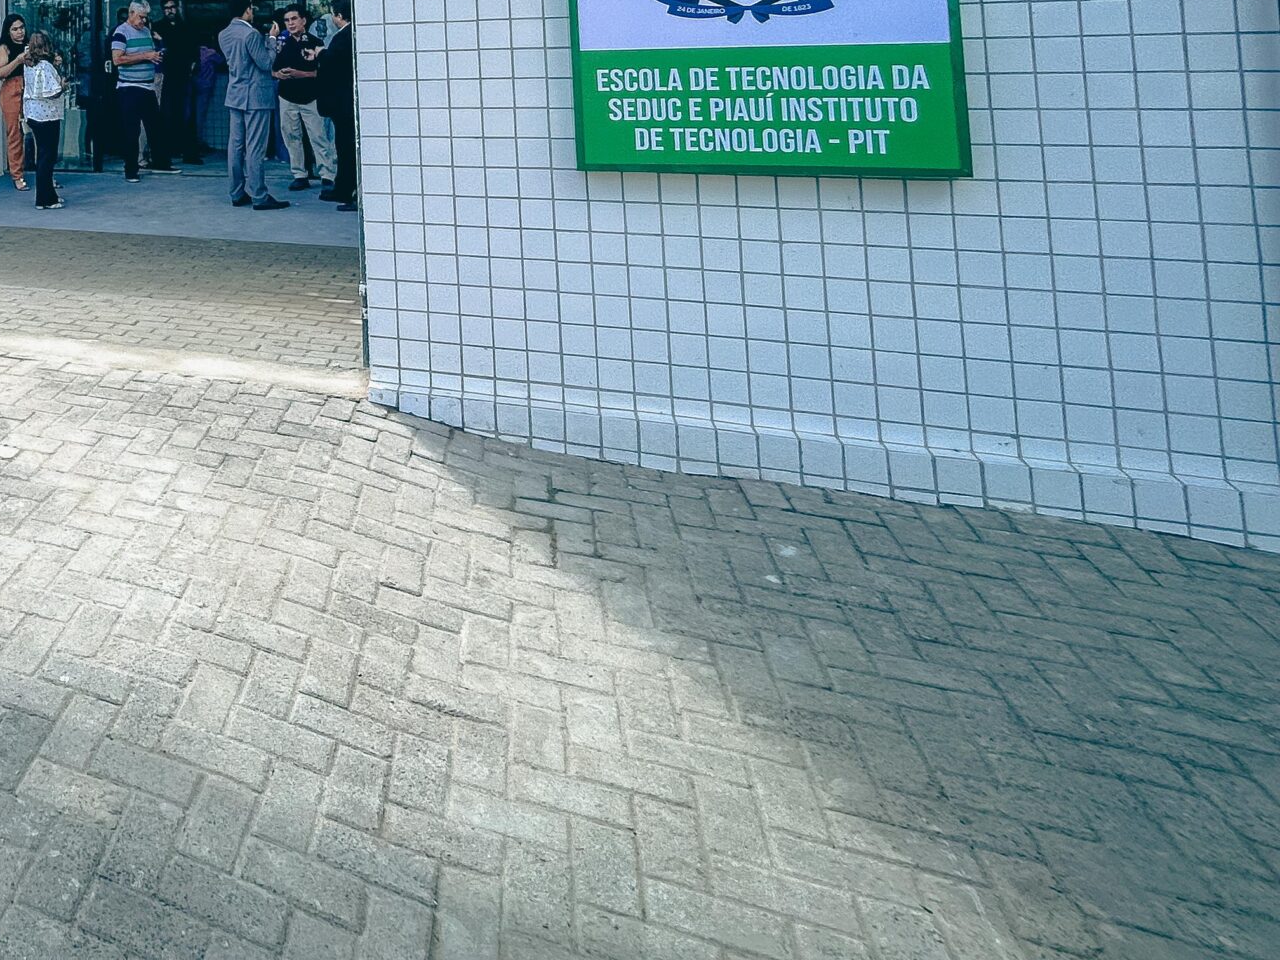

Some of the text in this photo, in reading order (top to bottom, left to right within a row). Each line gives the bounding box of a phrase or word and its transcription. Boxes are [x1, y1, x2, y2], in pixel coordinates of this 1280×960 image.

[596, 64, 931, 92] ESCOLA DE TECNOLOGIA DA
[608, 92, 919, 123] SEDUC E PIAUÍ INSTITUTO
[634, 127, 665, 151] DE
[669, 127, 822, 154] TECNOLOGIA
[847, 129, 890, 155] PIT
